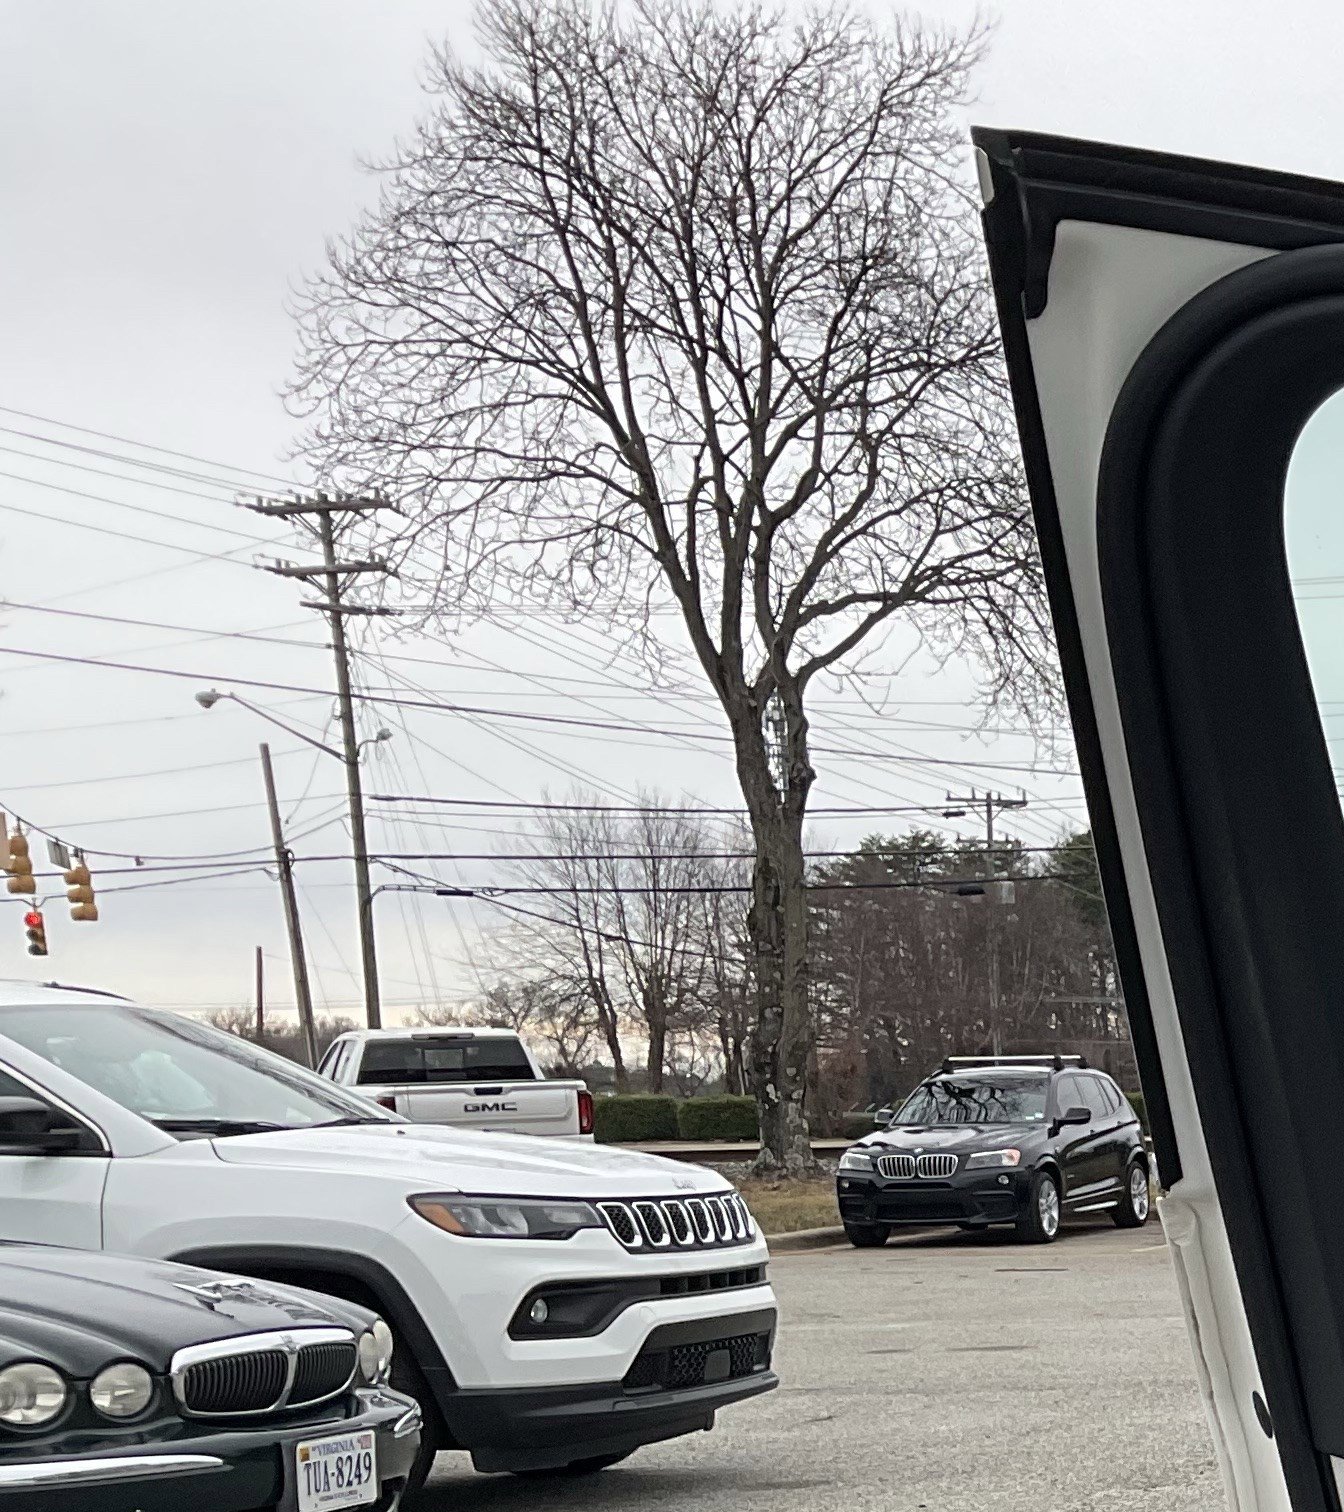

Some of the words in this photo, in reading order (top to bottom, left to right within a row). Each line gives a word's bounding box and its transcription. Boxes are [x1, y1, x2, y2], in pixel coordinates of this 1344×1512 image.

[464, 1102, 517, 1112] GMC
[318, 1439, 355, 1456] VIRGINIA
[304, 1452, 371, 1496] TUA-8249
